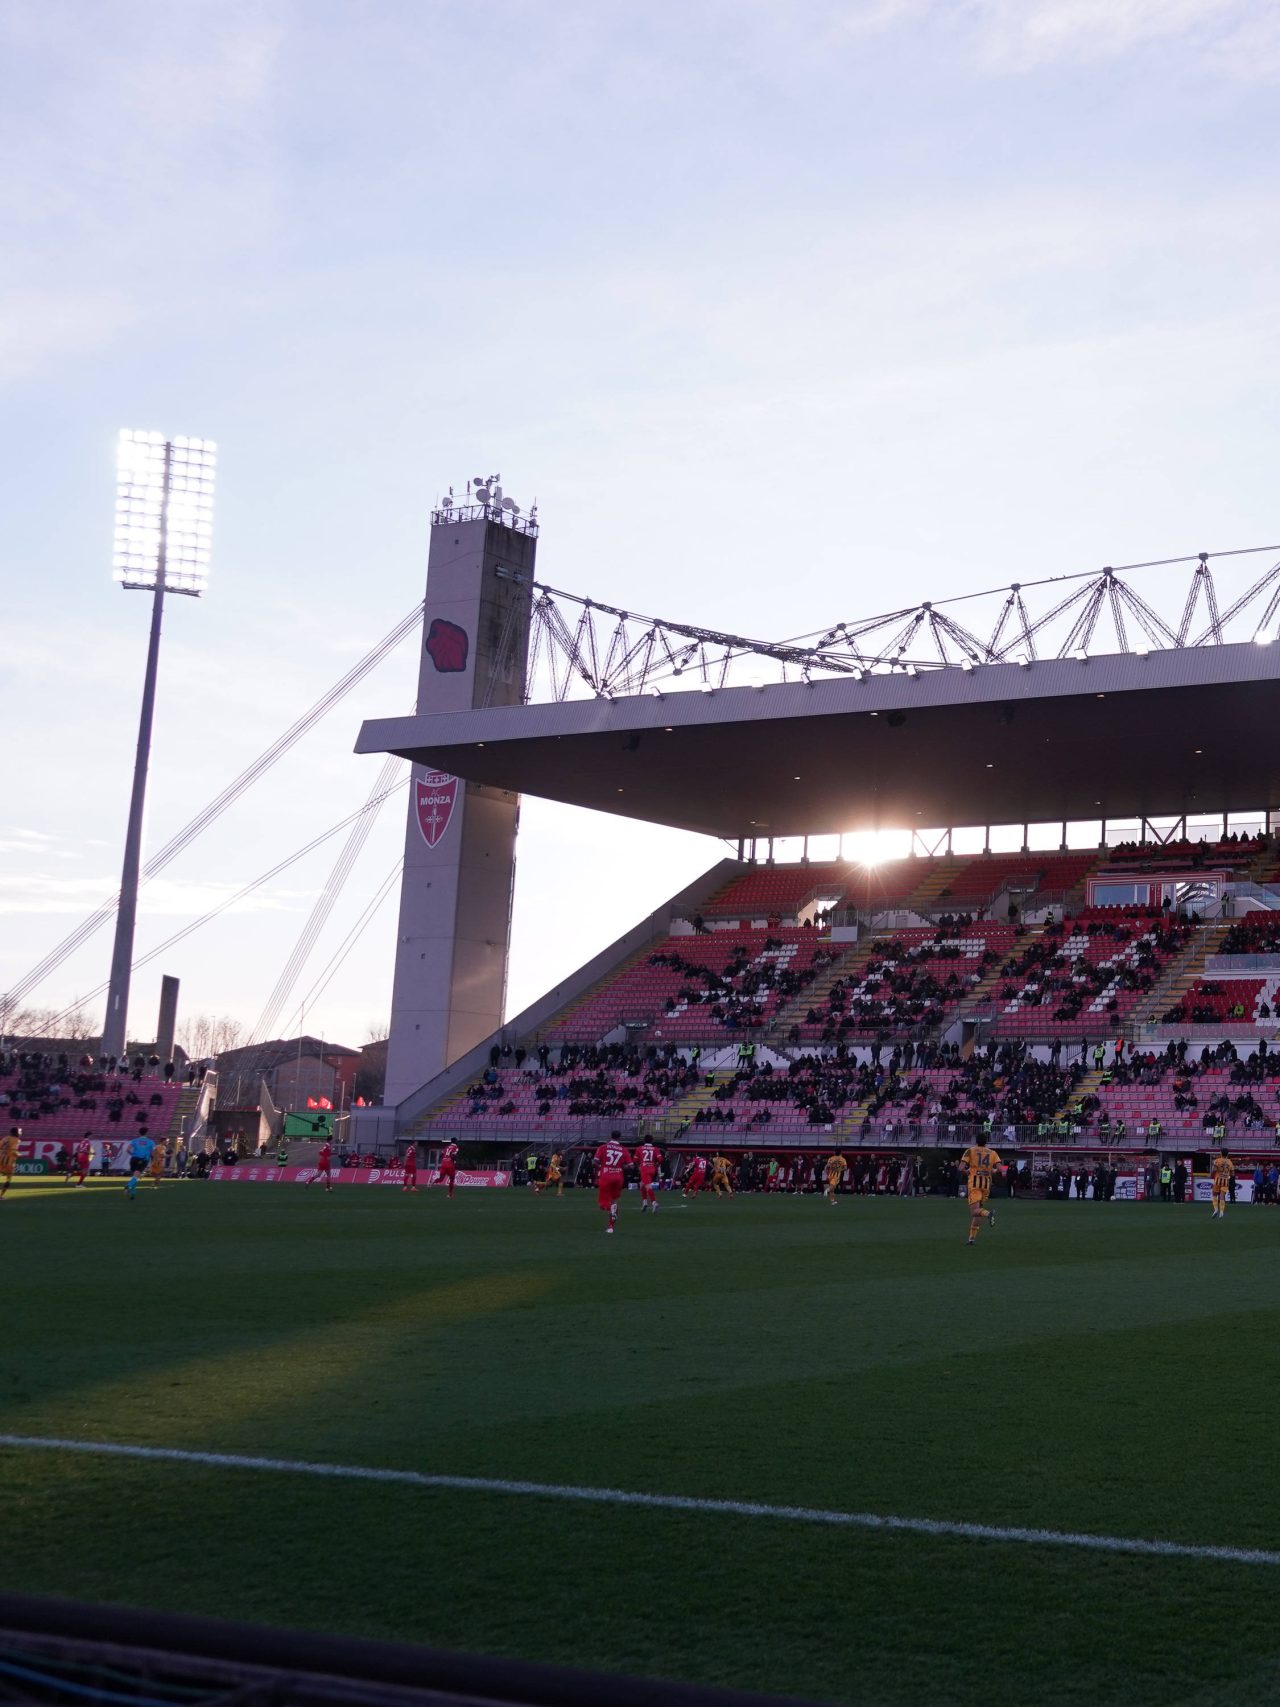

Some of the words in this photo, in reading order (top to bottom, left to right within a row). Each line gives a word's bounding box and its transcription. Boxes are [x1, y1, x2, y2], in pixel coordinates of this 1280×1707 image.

[431, 788, 441, 796] AC
[420, 796, 451, 806] MONZA
[605, 1149, 623, 1166] 37
[642, 1150, 654, 1162] 21
[977, 1152, 990, 1168] 14
